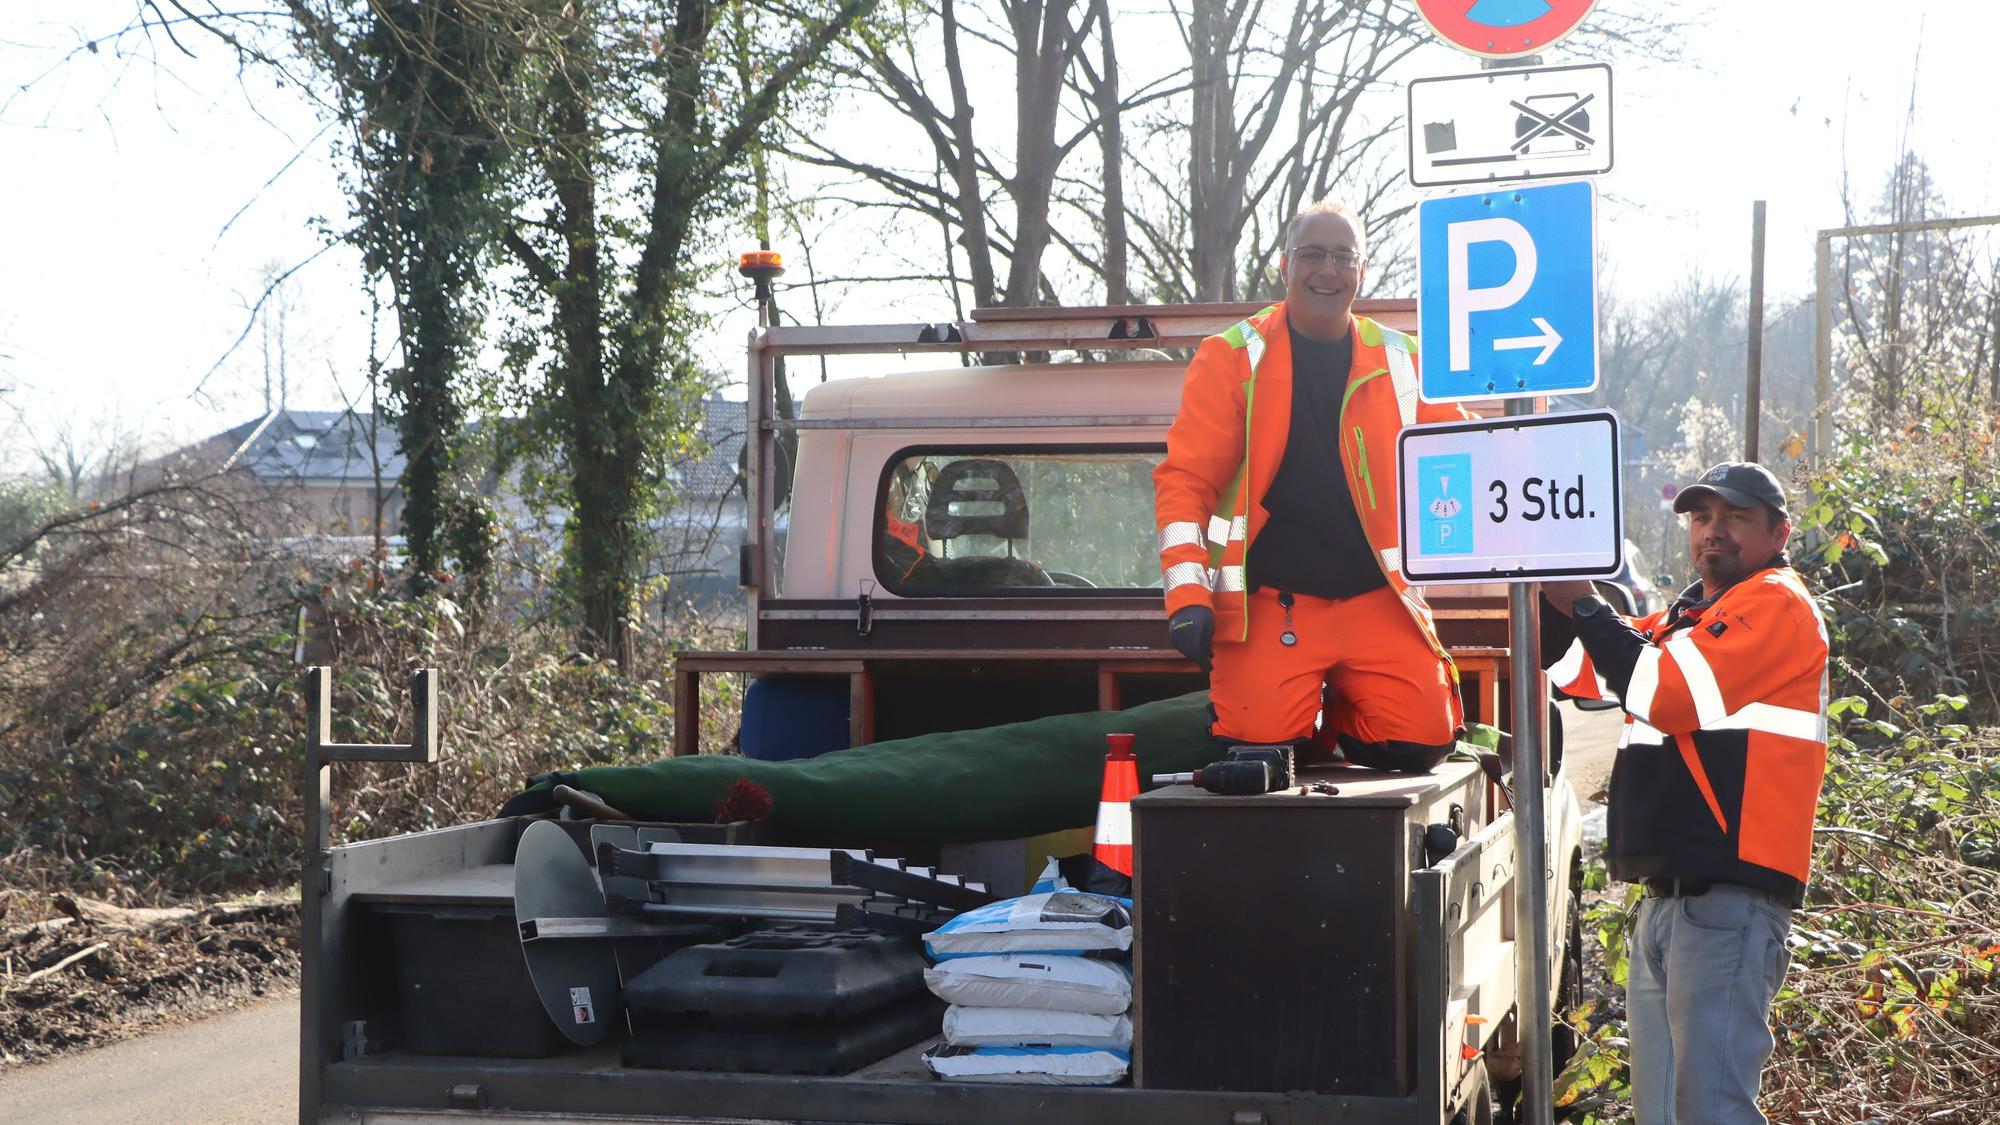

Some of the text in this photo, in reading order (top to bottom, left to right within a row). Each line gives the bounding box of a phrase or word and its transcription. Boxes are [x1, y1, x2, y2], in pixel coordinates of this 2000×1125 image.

[1448, 217, 1537, 371] P
[1489, 474, 1595, 523] 3 Std.
[1441, 523, 1452, 544] P
